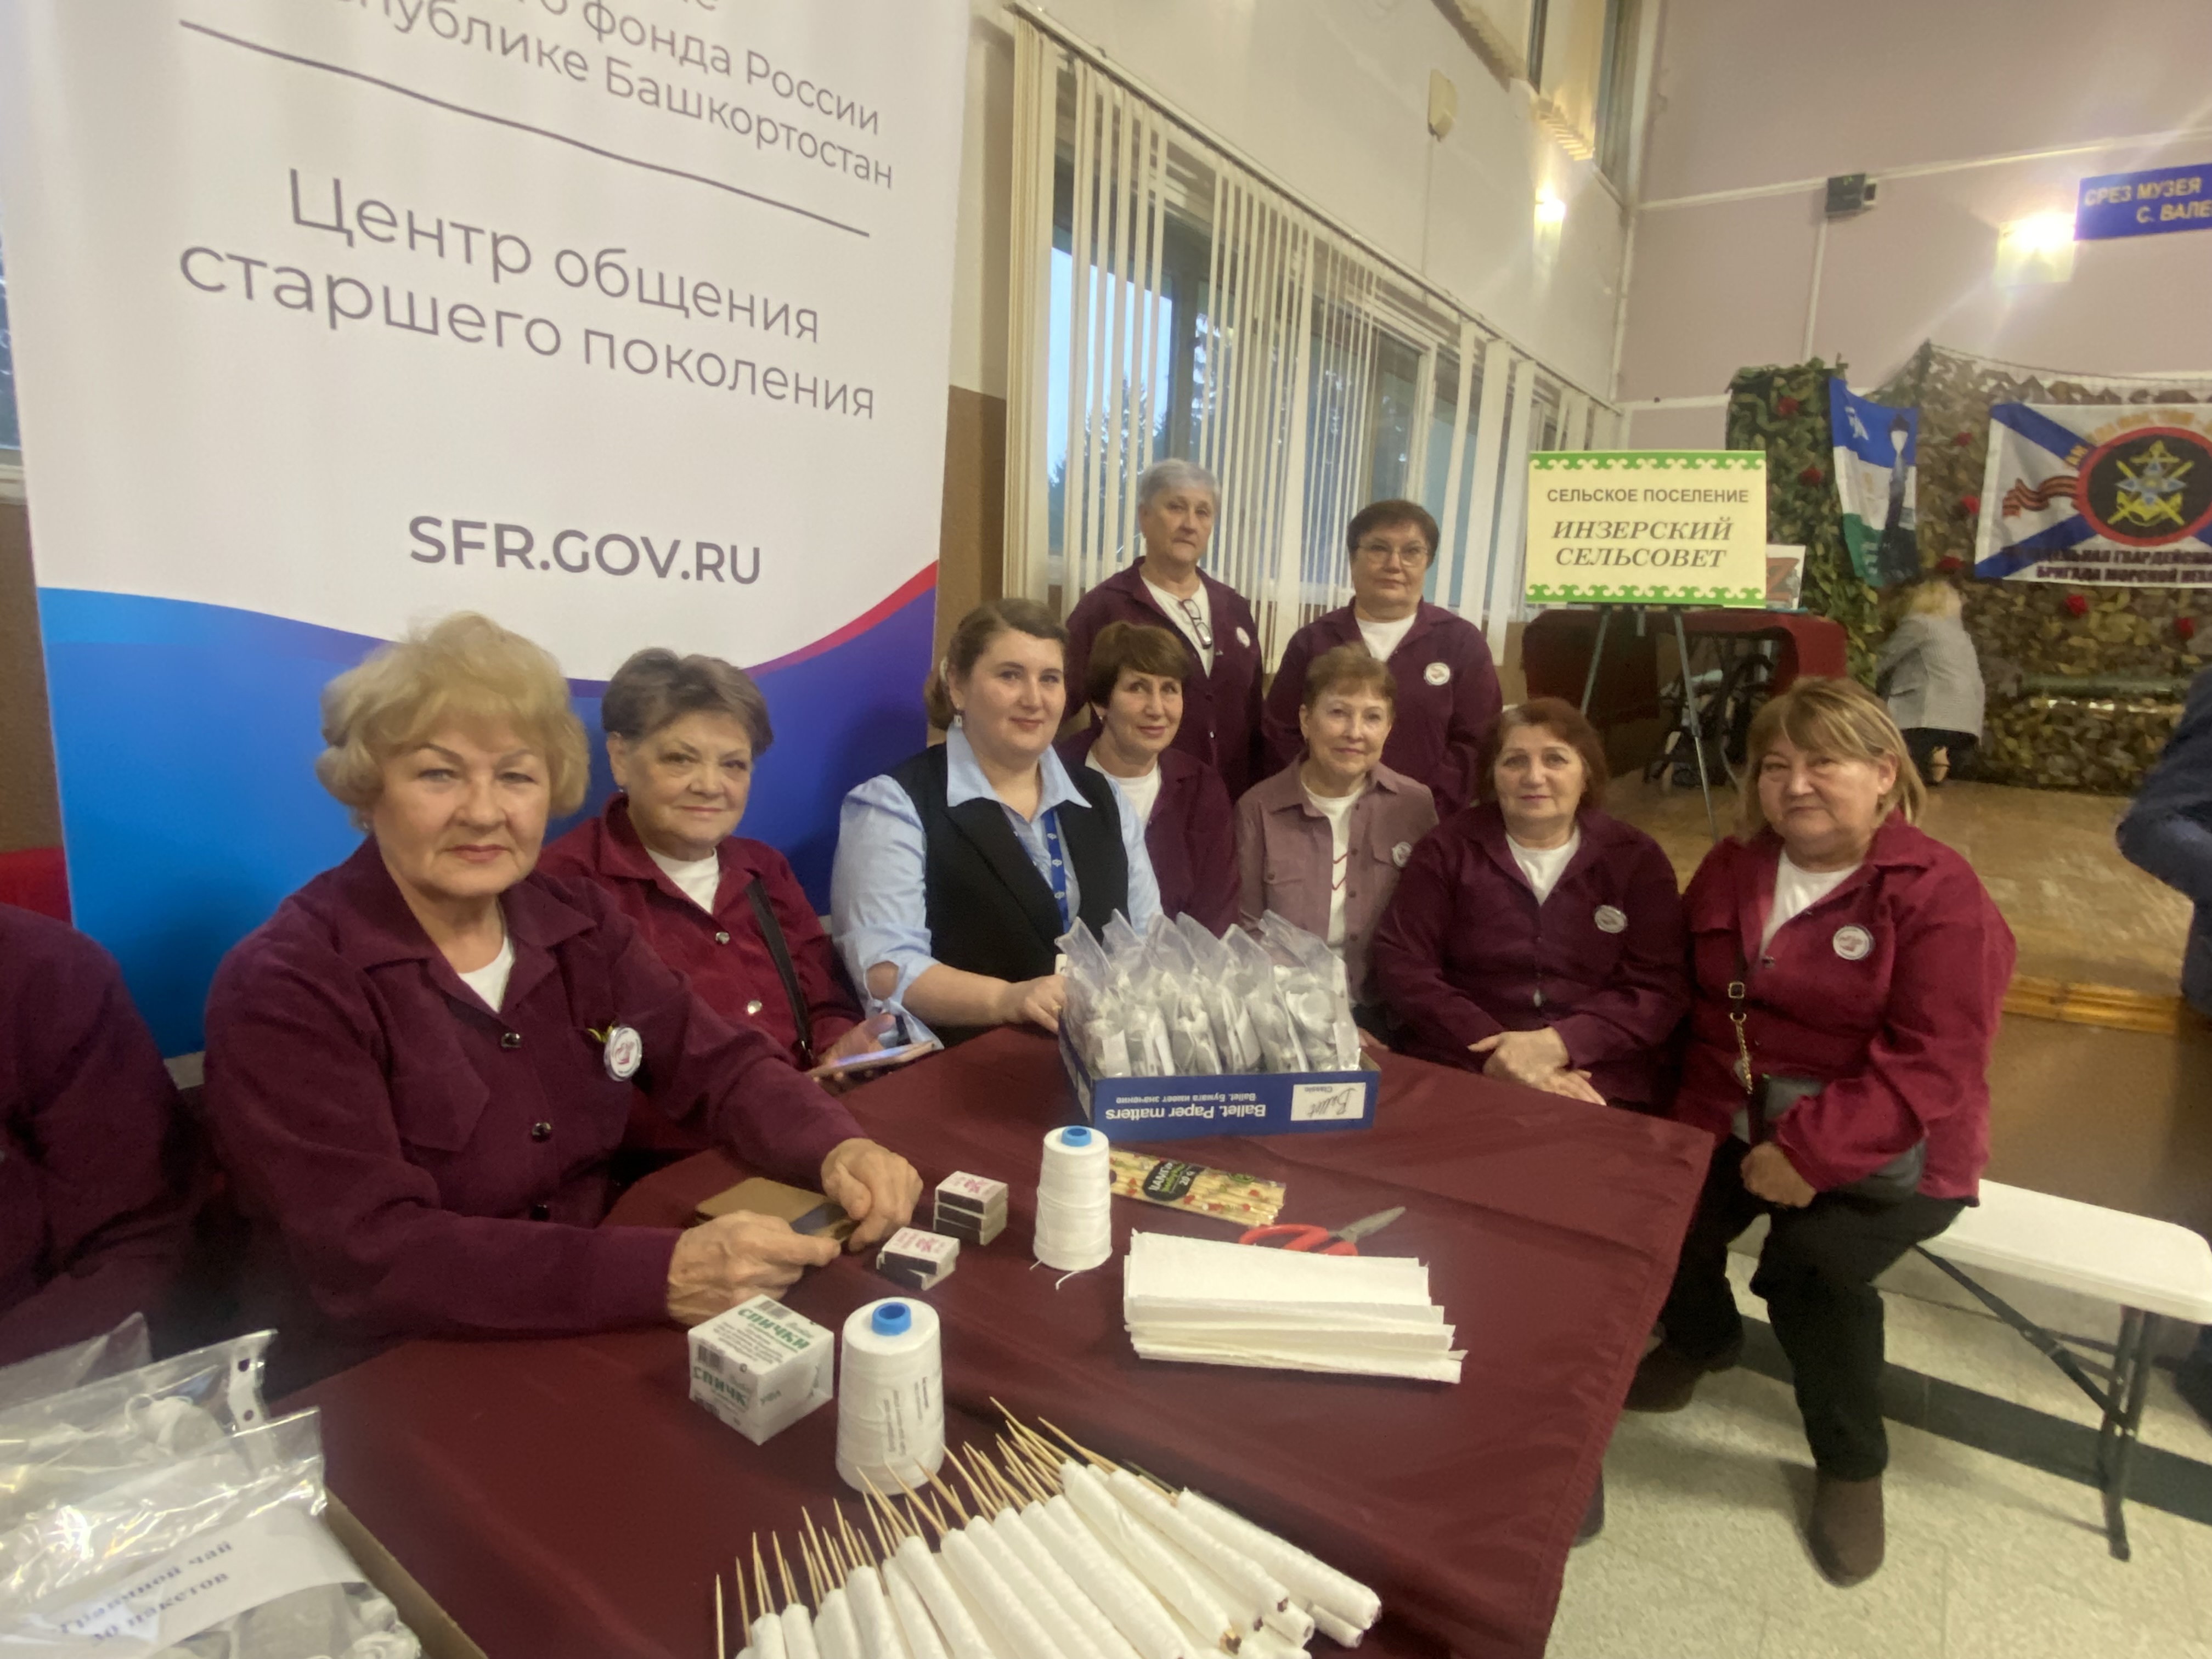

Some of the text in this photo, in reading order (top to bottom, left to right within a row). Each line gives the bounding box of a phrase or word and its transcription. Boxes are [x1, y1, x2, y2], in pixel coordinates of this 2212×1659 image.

[747, 50, 878, 135] России
[606, 56, 891, 189] Башкортостан
[2137, 177, 2201, 199] МУЗЕЯ
[290, 168, 817, 343] Центр общения
[180, 246, 873, 419] старшего поколения
[1547, 489, 1749, 503] СЕЛЬСКОЕ ПОСЕЛЕНИЕ
[1551, 517, 1734, 540] ИНЗЕРСКИЙ
[409, 516, 760, 584] SFR.GOV.RU
[1556, 548, 1727, 568] СЕЛЬСОВЕТ
[1105, 1103, 1266, 1121] Ballet. Paper matters
[1193, 1092, 1225, 1102] Бумага
[738, 1308, 810, 1350] СПИЧКИ
